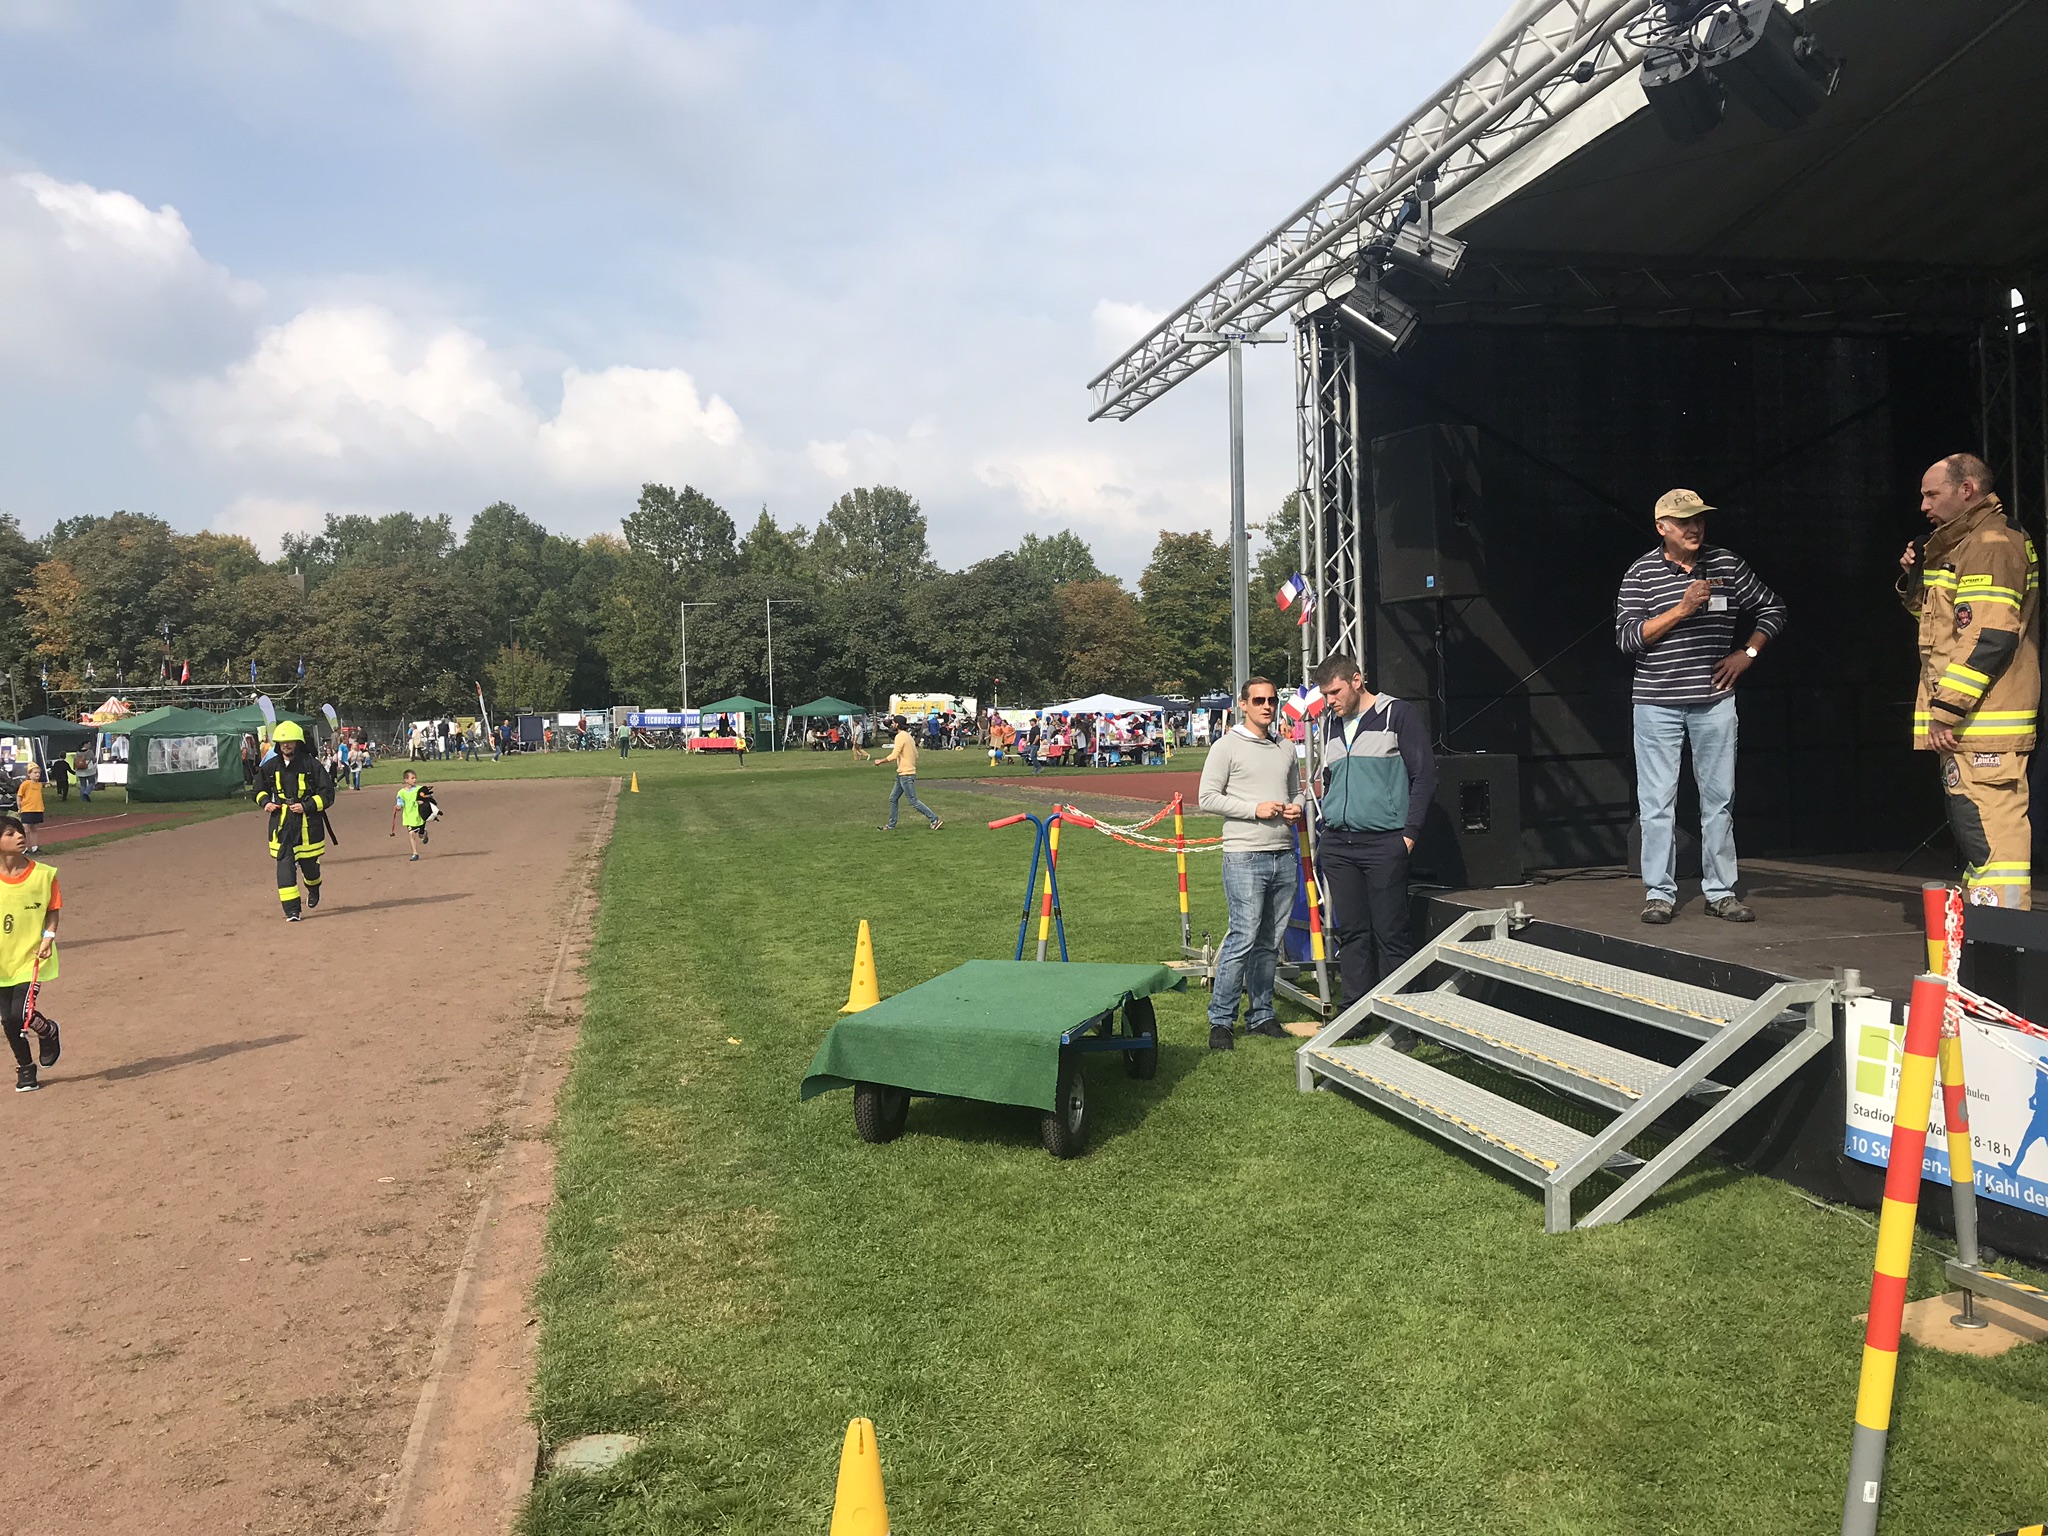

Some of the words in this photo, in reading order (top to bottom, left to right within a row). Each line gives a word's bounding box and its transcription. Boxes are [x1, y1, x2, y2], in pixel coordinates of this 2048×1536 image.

[3, 913, 14, 934] 6
[1964, 1085, 1990, 1102] hulen
[2003, 1143, 2011, 1157] h
[1852, 1135, 1868, 1153] 10
[1985, 1172, 2020, 1199] Kahl
